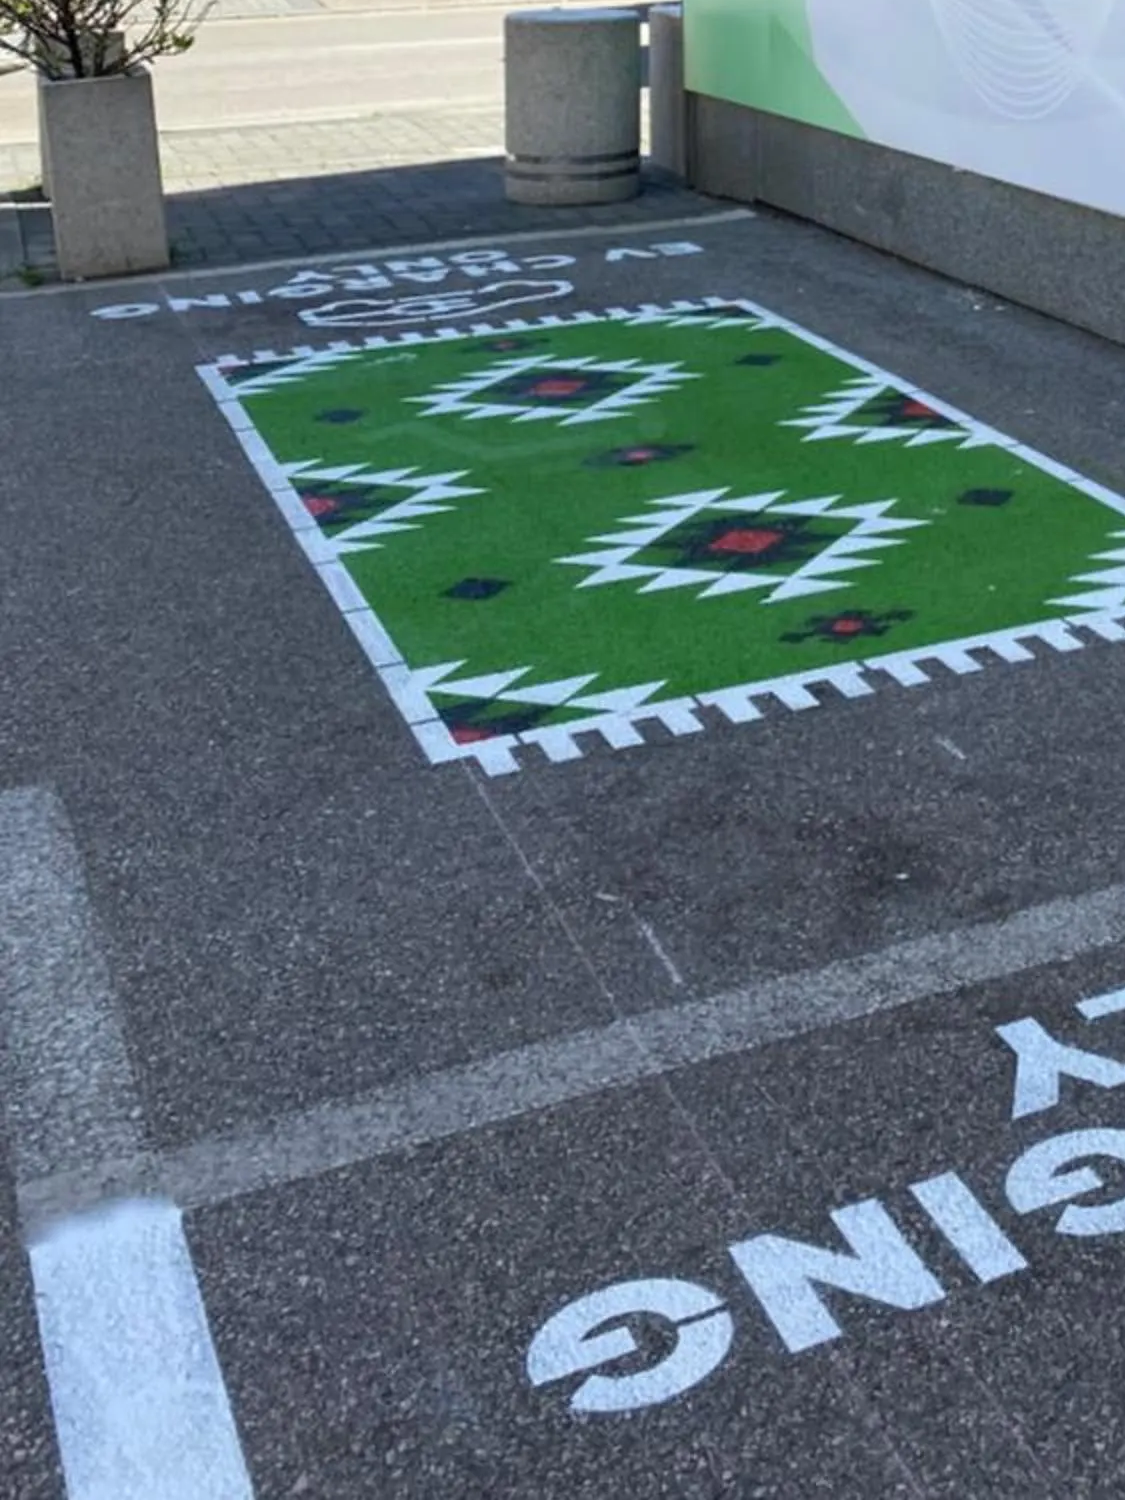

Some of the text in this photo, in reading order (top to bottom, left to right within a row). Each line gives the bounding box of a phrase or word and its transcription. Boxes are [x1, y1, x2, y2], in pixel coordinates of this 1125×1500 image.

[90, 242, 702, 319] EV CHARGING
[288, 250, 507, 283] ONLY
